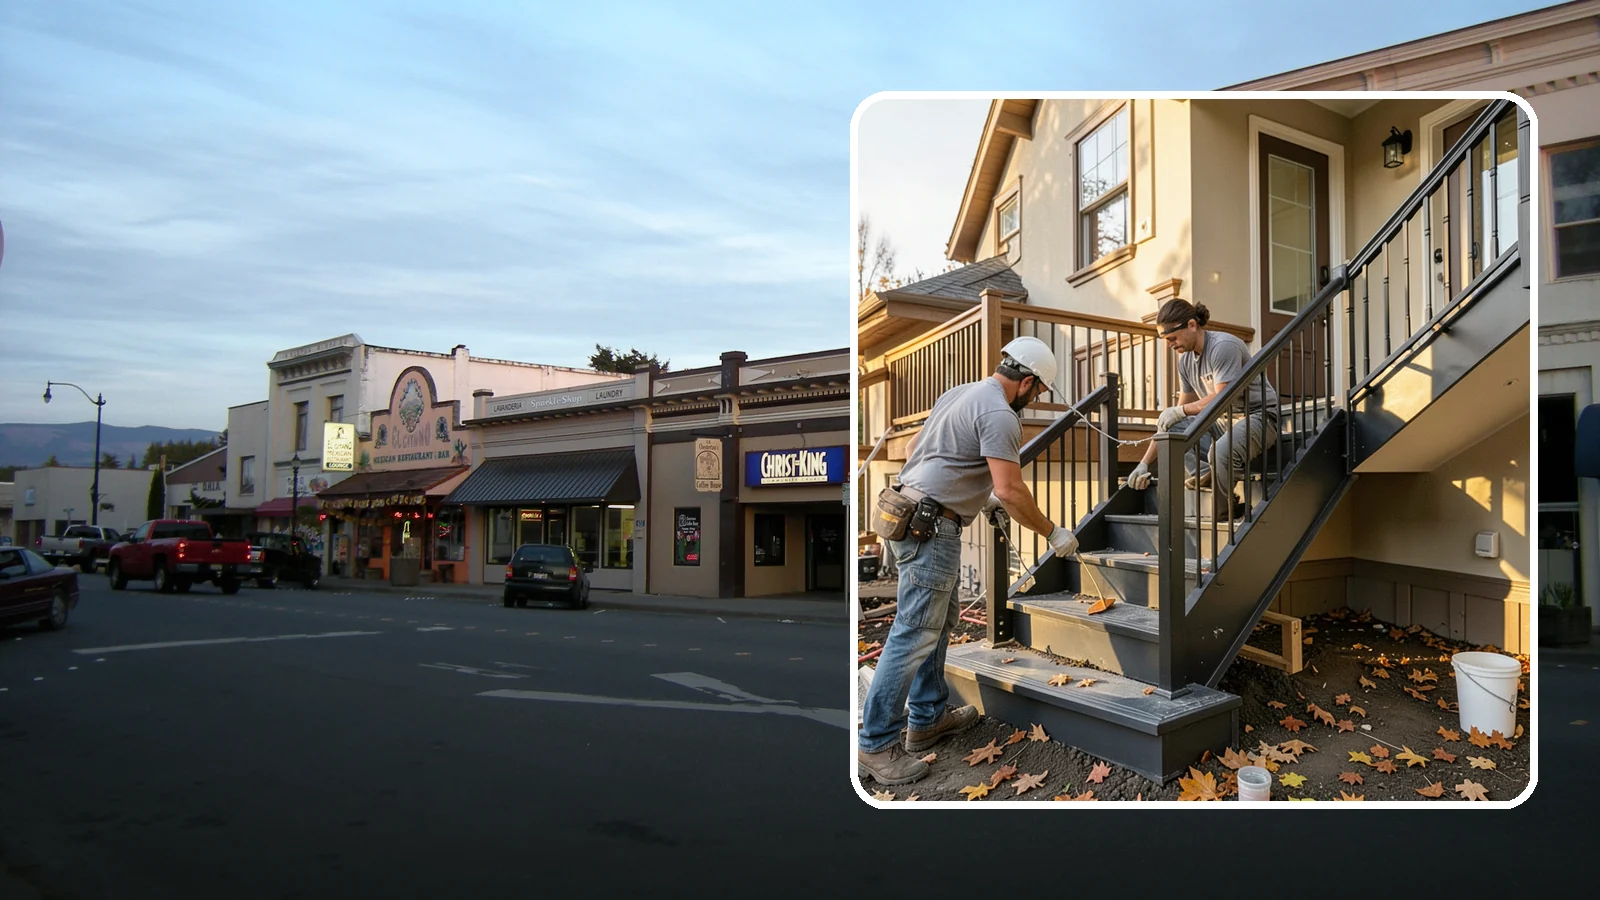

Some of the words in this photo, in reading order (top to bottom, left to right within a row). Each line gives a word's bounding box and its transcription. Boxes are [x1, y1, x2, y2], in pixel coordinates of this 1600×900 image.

[493, 402, 522, 413] LAVANDERIA
[561, 395, 582, 406] Shop
[595, 389, 623, 400] LAUNDRY
[374, 455, 396, 464] MEXICAN
[398, 451, 434, 463] RESTAURANT
[438, 450, 450, 459] BAR
[761, 452, 797, 478] CHRIST
[799, 450, 828, 476] KING
[696, 480, 709, 489] Coffee
[710, 480, 722, 489] House
